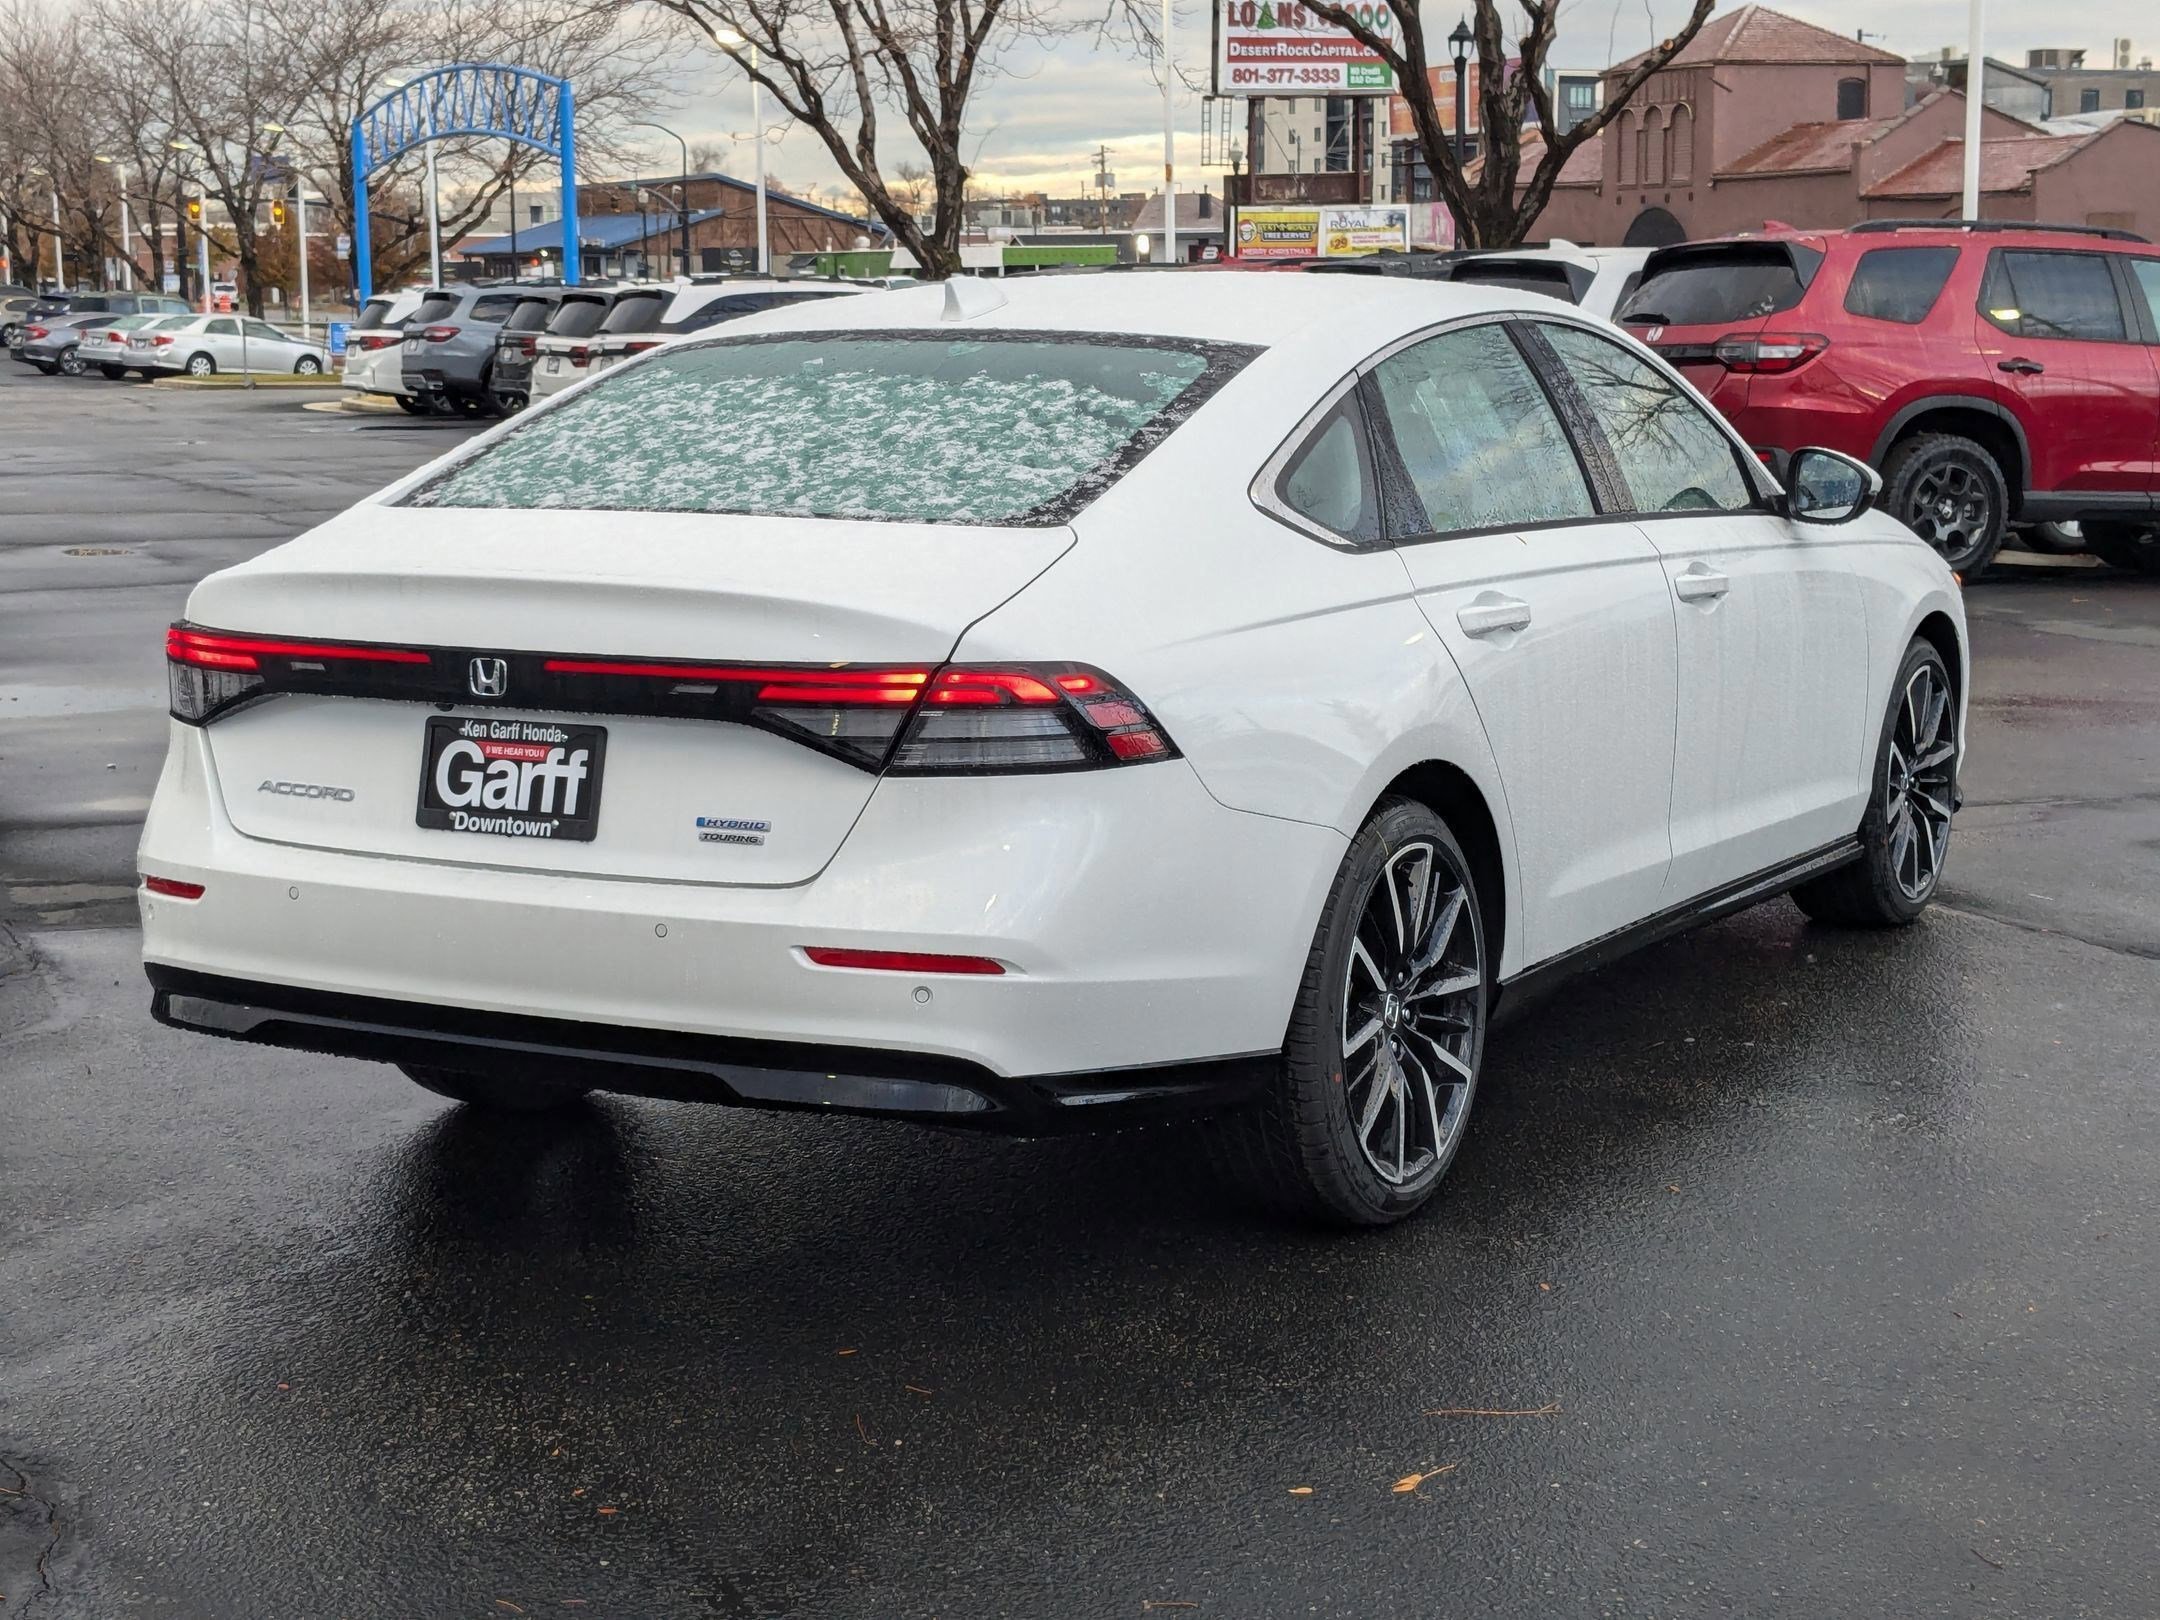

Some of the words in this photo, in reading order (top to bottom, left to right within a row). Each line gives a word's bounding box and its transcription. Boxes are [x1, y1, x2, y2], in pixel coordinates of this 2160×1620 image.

[1232, 68, 1341, 83] 801-377-3333
[1330, 218, 1369, 228] ROYAL
[1242, 248, 1267, 256] MERRY
[464, 720, 487, 737] Ken
[490, 721, 519, 740] Garff
[523, 723, 562, 743] Honda
[491, 745, 502, 755] WE
[504, 747, 524, 756] HEAR
[525, 748, 540, 758] YOU
[436, 739, 588, 815] Garff
[257, 780, 355, 802] ACCORD
[454, 811, 552, 837] Downtown
[706, 819, 766, 830] HYBRID
[703, 833, 759, 844] TOURING
